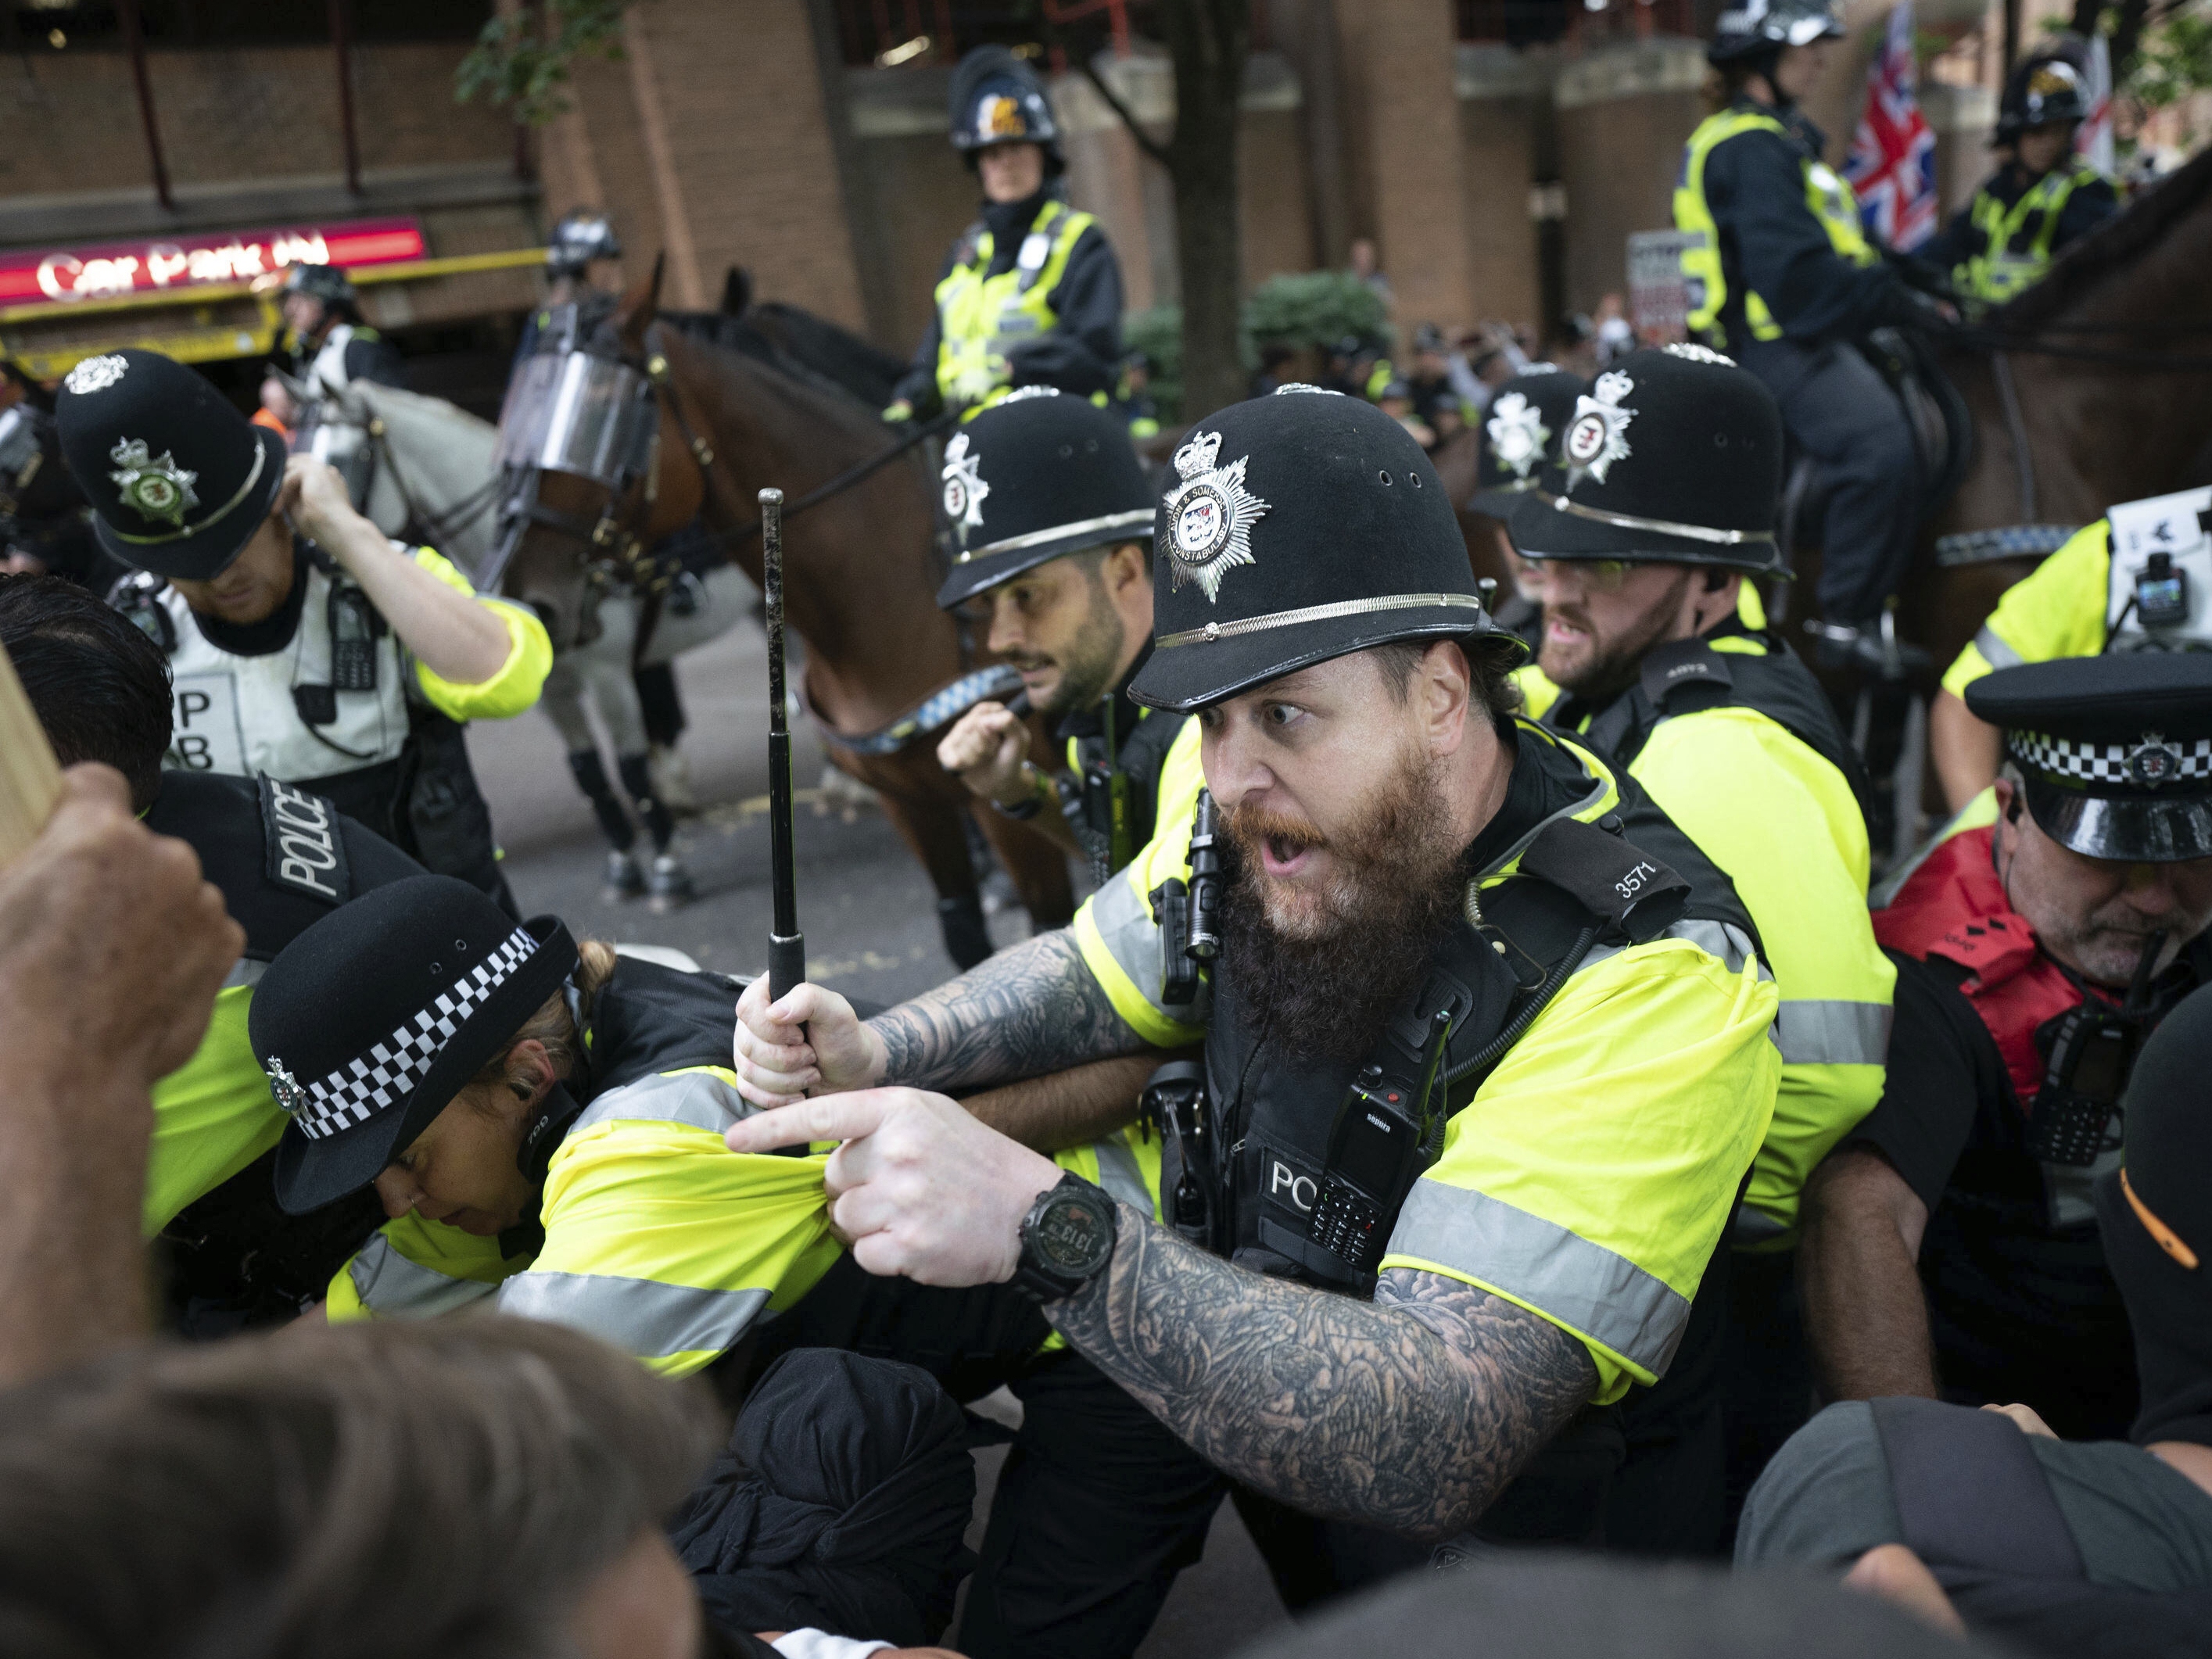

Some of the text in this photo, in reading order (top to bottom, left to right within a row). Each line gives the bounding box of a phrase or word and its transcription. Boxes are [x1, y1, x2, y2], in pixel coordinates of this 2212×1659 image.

[36, 253, 139, 302] Car
[146, 237, 265, 287] Park
[1192, 486, 1228, 512] SOMERSET
[1172, 522, 1227, 561] CONSTABULARY
[271, 779, 338, 897] POLICE
[1615, 861, 1657, 899] 3571
[1367, 1113, 1391, 1134] sepura
